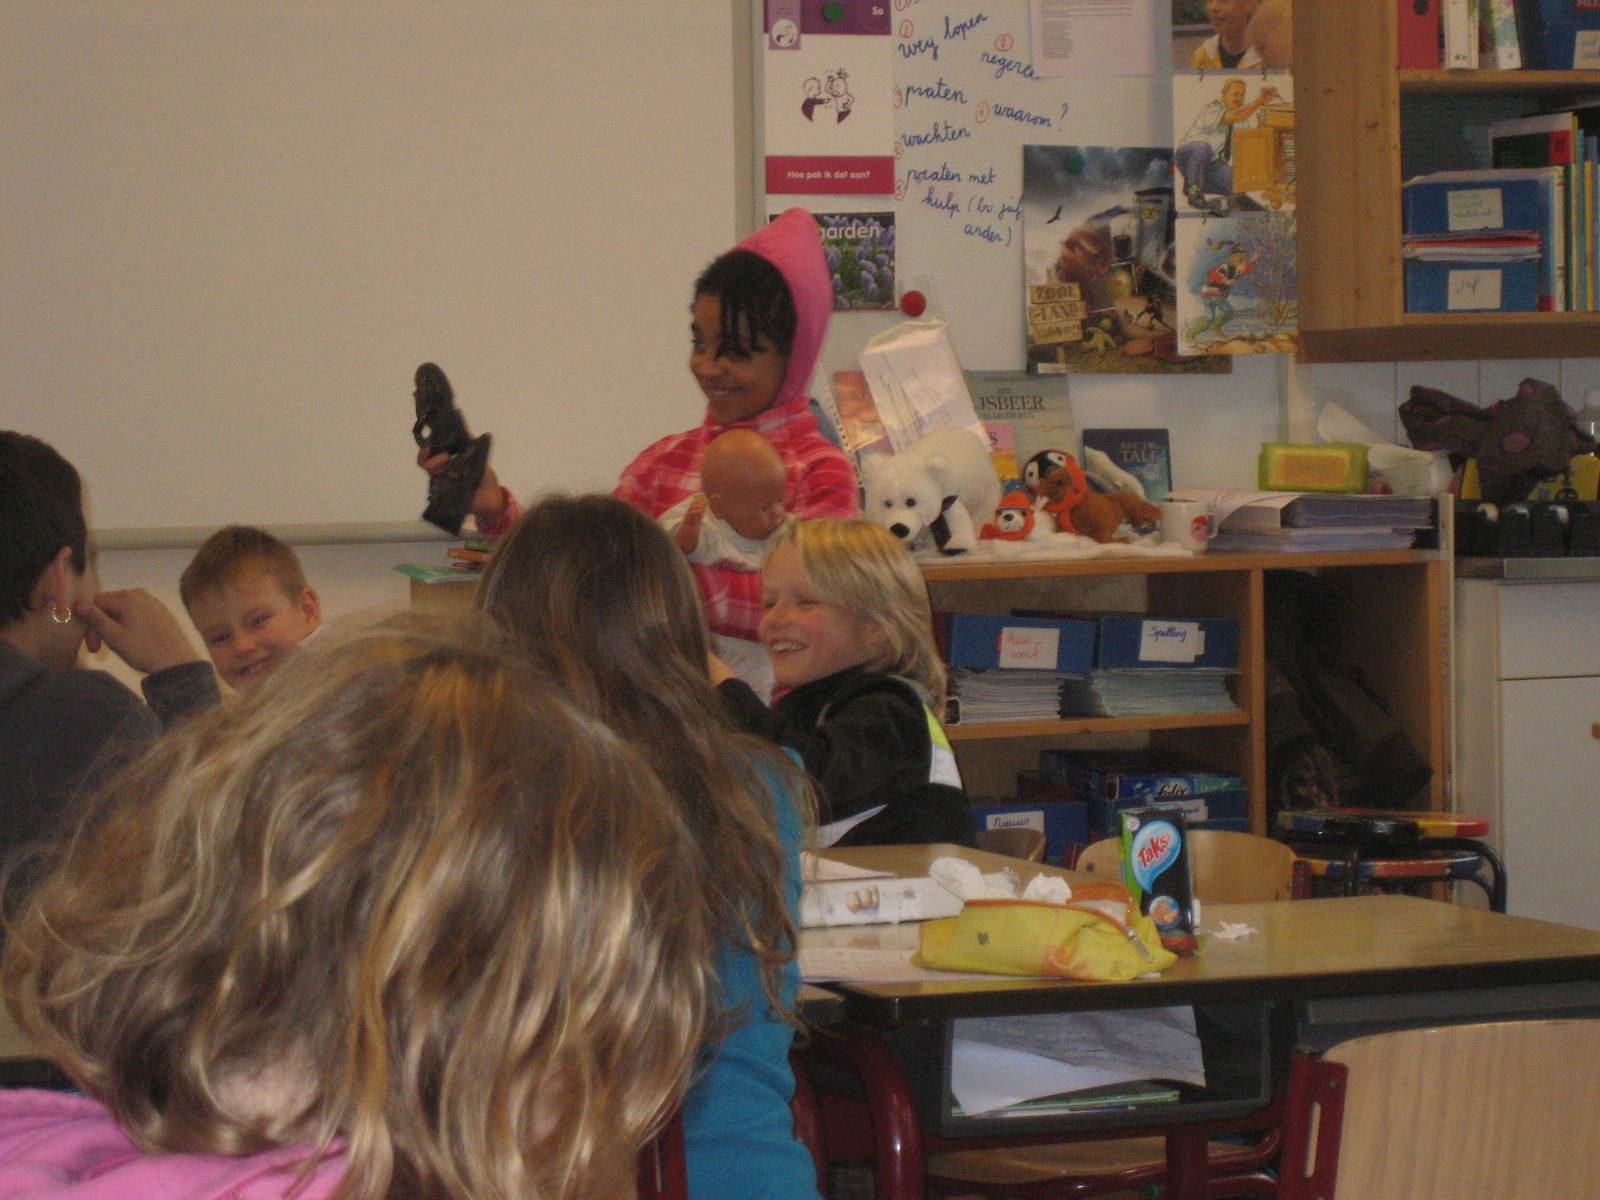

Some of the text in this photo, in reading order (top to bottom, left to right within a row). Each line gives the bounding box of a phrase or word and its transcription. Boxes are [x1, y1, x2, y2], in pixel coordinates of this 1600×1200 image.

[945, 13, 988, 40] lopen
[905, 77, 968, 106] praten
[993, 102, 1052, 127] waarom
[901, 120, 971, 147] wachten
[787, 170, 871, 180] Hoe pak ik dat aan?
[905, 162, 961, 191] praten
[970, 166, 997, 184] met
[921, 186, 960, 218] hulp
